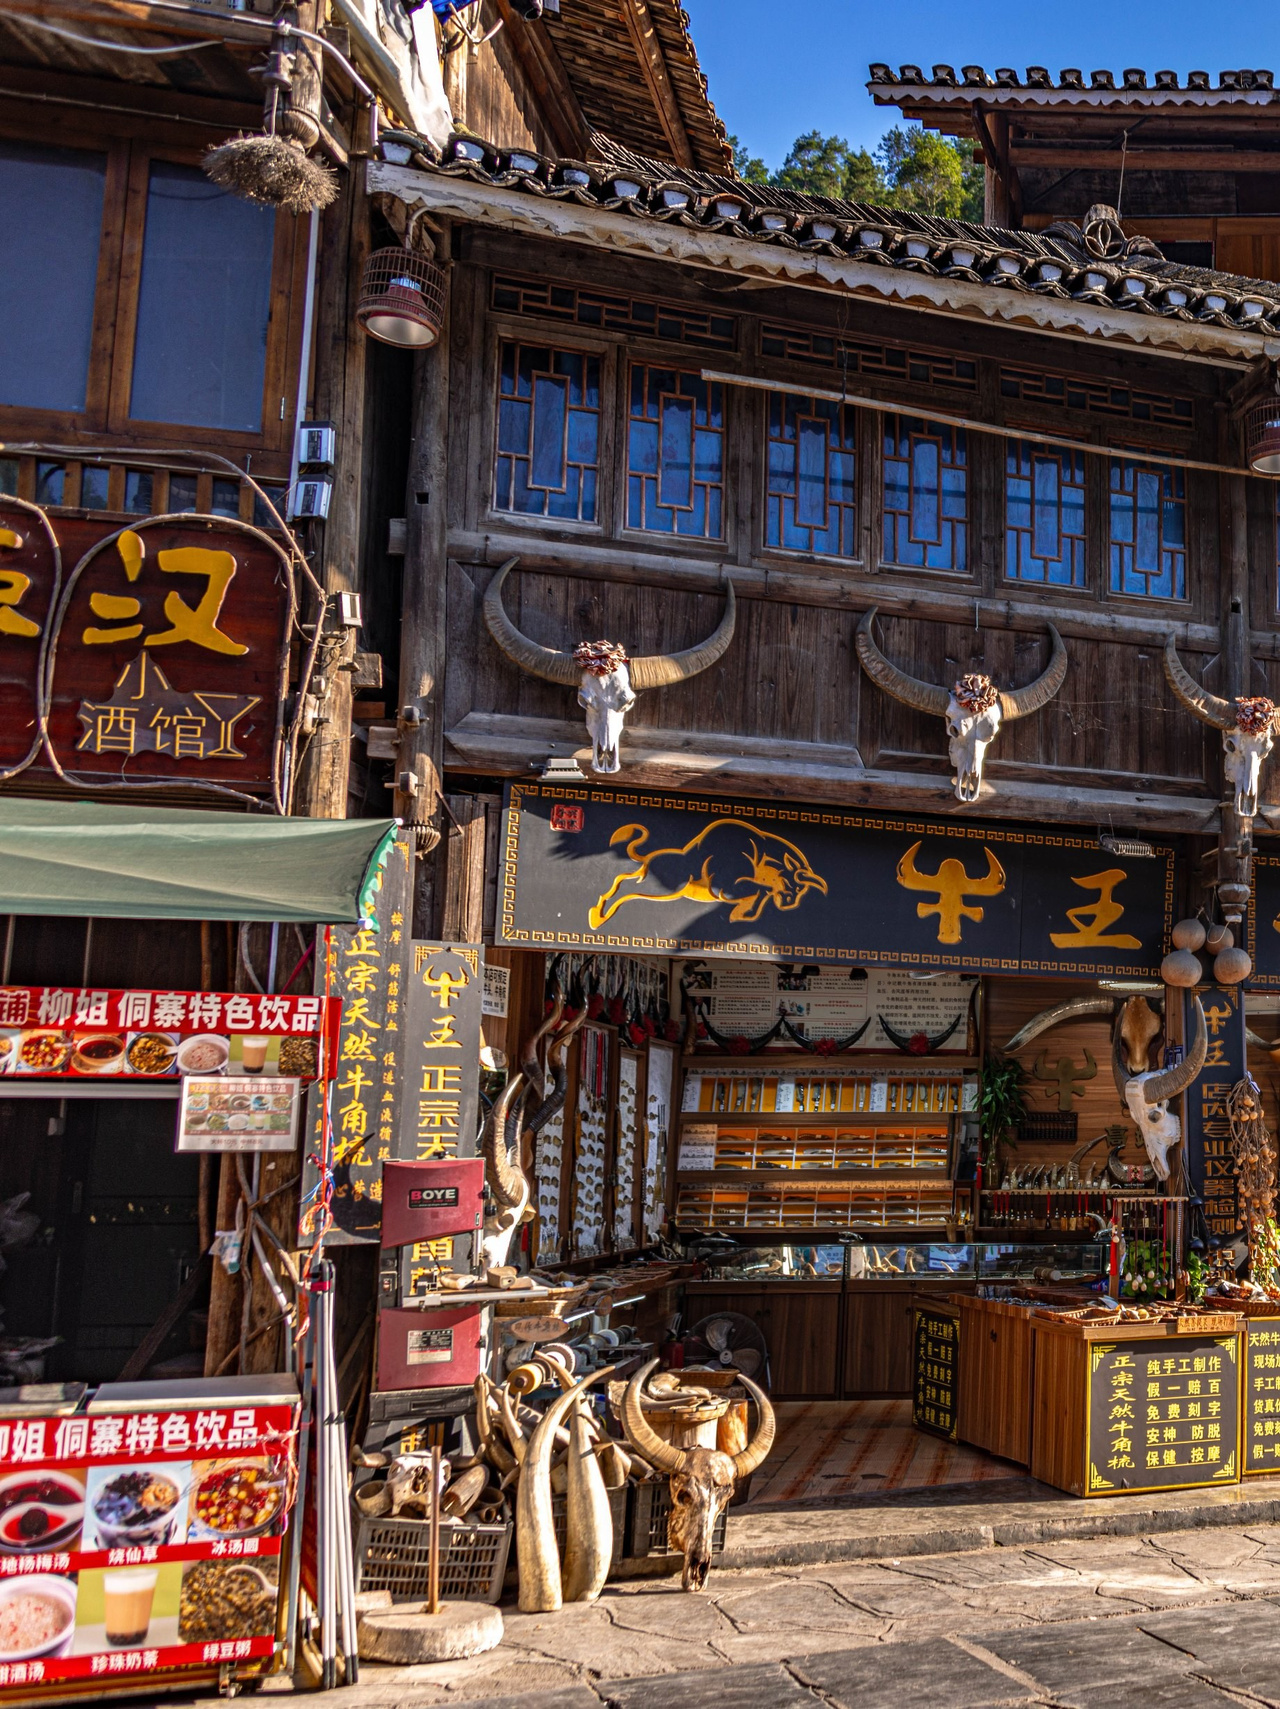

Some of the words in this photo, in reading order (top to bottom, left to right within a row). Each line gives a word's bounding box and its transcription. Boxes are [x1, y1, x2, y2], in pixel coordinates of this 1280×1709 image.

[82, 530, 250, 656] 汉
[77, 700, 207, 758] 酒馆
[390, 911, 404, 945] 按摩
[385, 963, 401, 1031] 舒筋活血
[37, 987, 109, 1026] 柳姐
[117, 991, 321, 1032] 侗寨特色饮品
[334, 930, 382, 1166] 正宗天然牛角梳
[1202, 1083, 1236, 1235] 店内专业仪器检测
[411, 1189, 456, 1200] BOYE
[1147, 1356, 1221, 1374] 纯手工制作
[1147, 1378, 1221, 1397] 假一赔百
[1107, 1355, 1137, 1470] 正宗天然牛角梳
[1146, 1401, 1221, 1420] 免费刻字
[54, 1409, 258, 1460] 侗寨特色饮品
[1146, 1427, 1176, 1443] 安神
[1191, 1423, 1221, 1440] 防脱
[1146, 1449, 1176, 1466] 保健
[1190, 1446, 1221, 1463] 按摩
[0, 1553, 70, 1574] 地杨梅汤
[109, 1546, 158, 1565] 烧仙草
[92, 1650, 158, 1672] 珍珠奶茶
[203, 1640, 252, 1661] 绿豆粥
